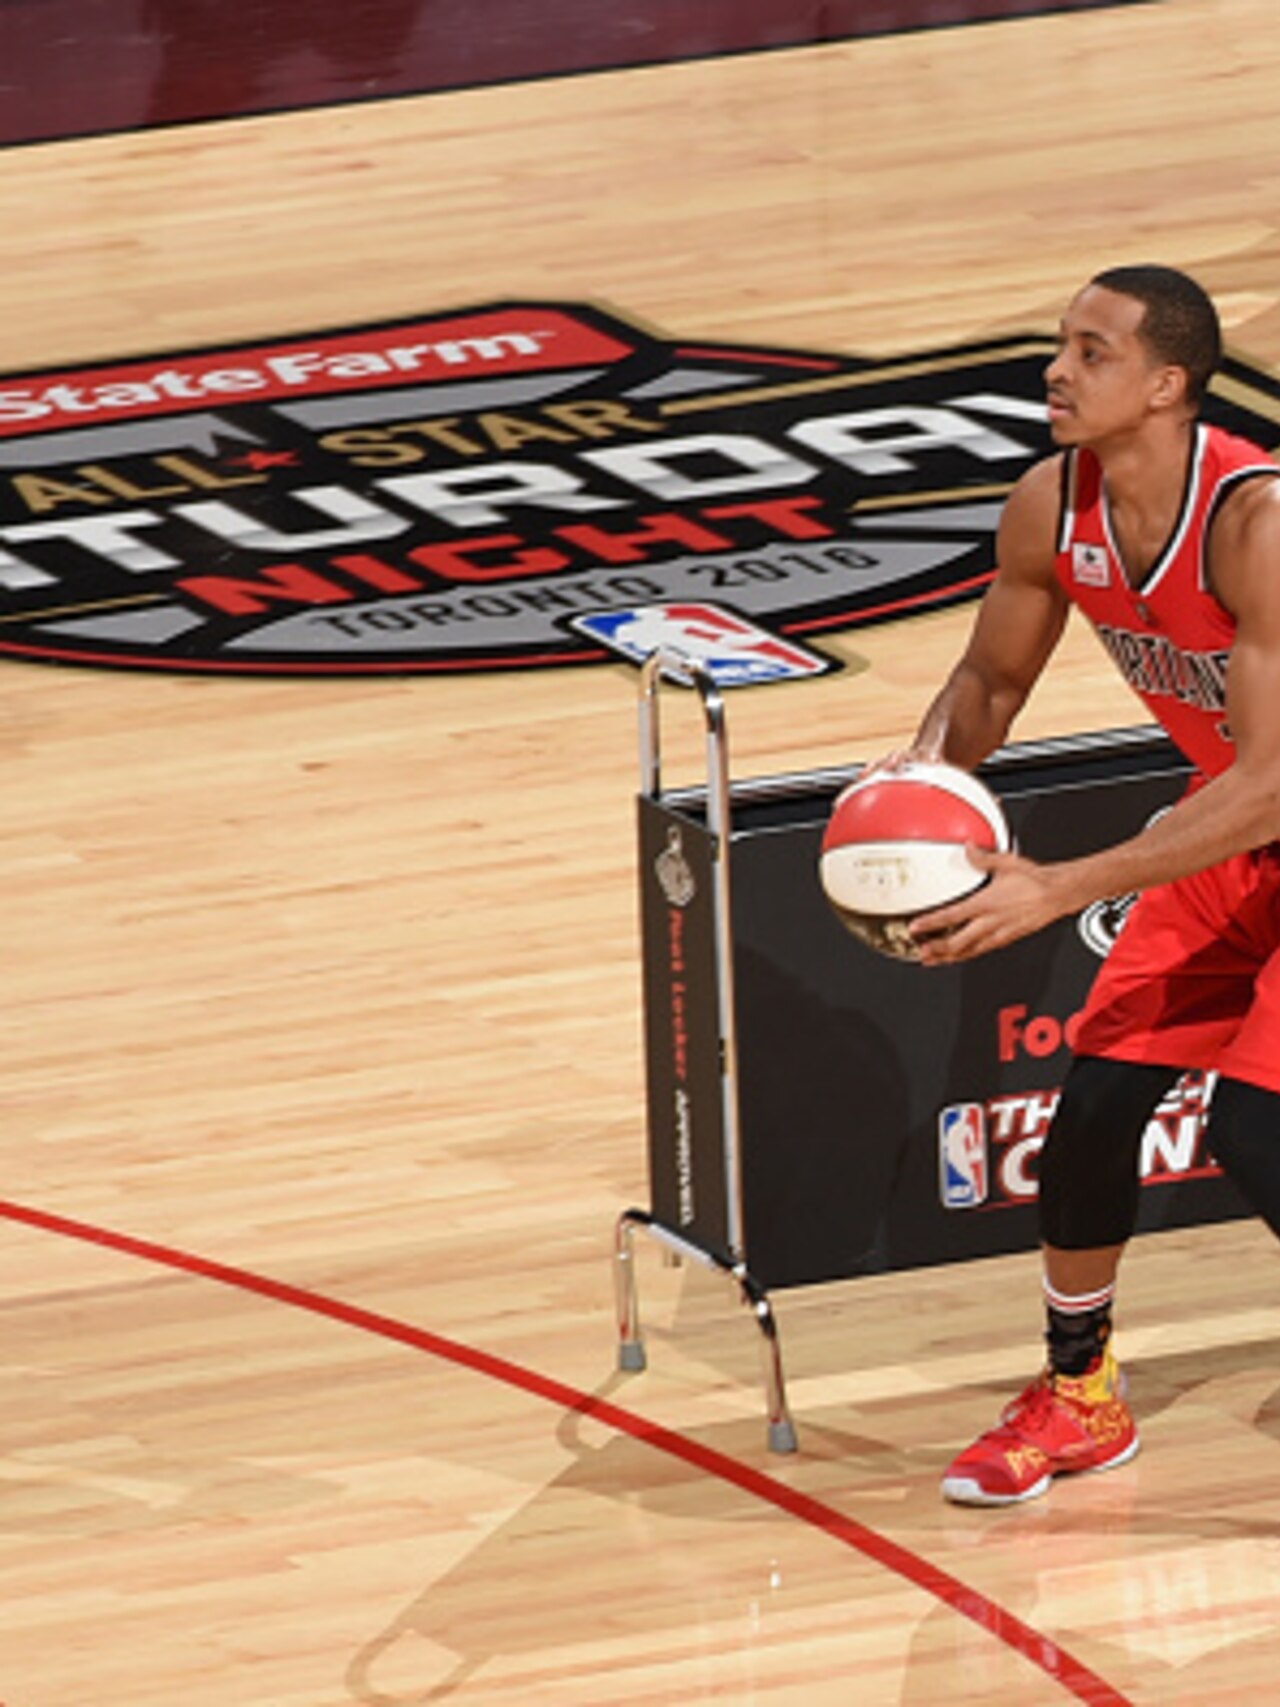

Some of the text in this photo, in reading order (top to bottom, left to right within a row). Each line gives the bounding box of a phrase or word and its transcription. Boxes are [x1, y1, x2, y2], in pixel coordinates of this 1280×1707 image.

[10, 400, 665, 513] ALL STAR
[172, 495, 837, 616] NIGHT
[306, 547, 880, 638] TORONTO 2016
